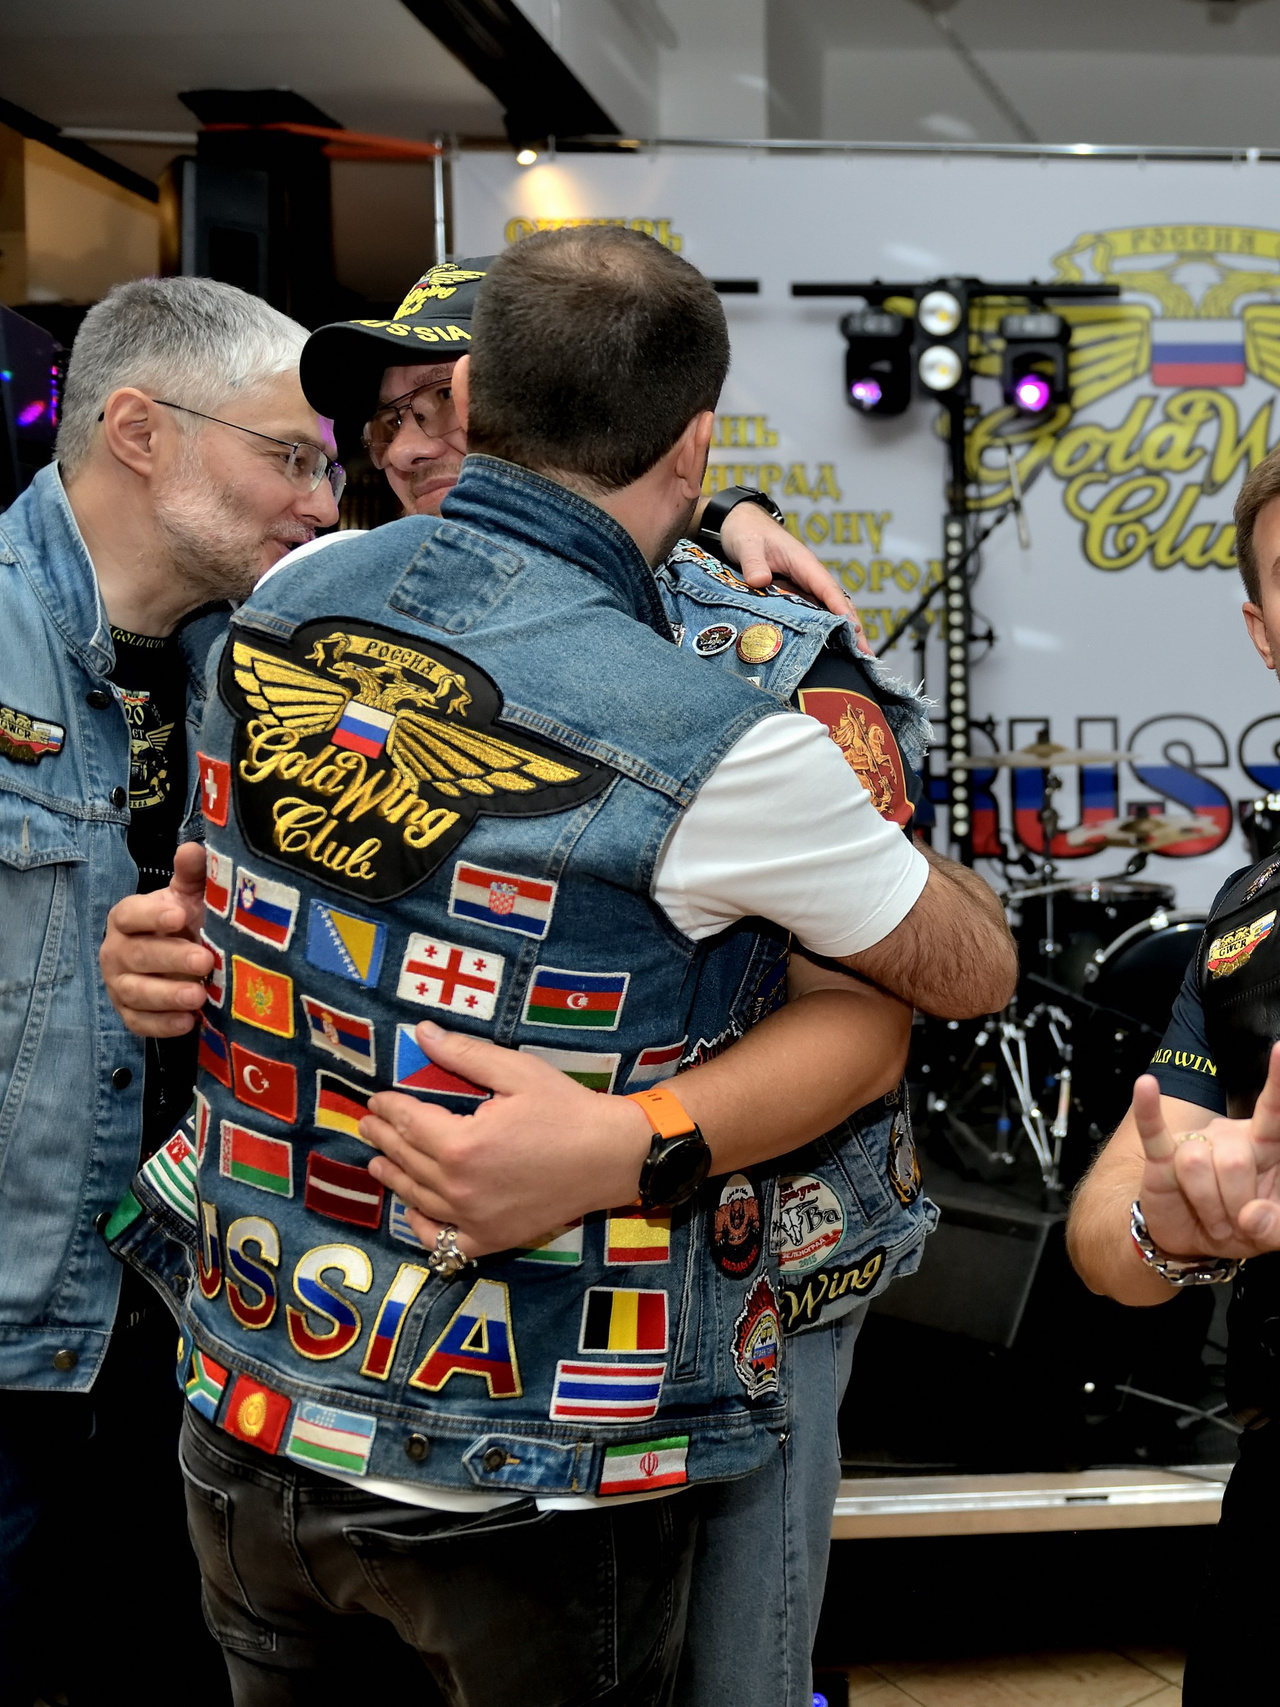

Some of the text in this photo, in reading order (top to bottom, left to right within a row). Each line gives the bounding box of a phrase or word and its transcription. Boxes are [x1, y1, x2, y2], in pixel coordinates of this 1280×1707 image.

[1130, 227, 1256, 256] РОССИЯ
[349, 319, 472, 343] USSIA
[964, 390, 1203, 512] Gold
[702, 462, 843, 502] НГРАД
[1063, 472, 1240, 571] Clu
[146, 638, 167, 649] WIN
[364, 641, 437, 676] РОССИЯ
[132, 728, 145, 739] ЕТ
[238, 719, 462, 849] Gold Wing
[272, 796, 382, 881] Club
[1174, 1050, 1218, 1077] WIN
[198, 1200, 524, 1399] USSIA
[783, 1253, 882, 1328] Wing
